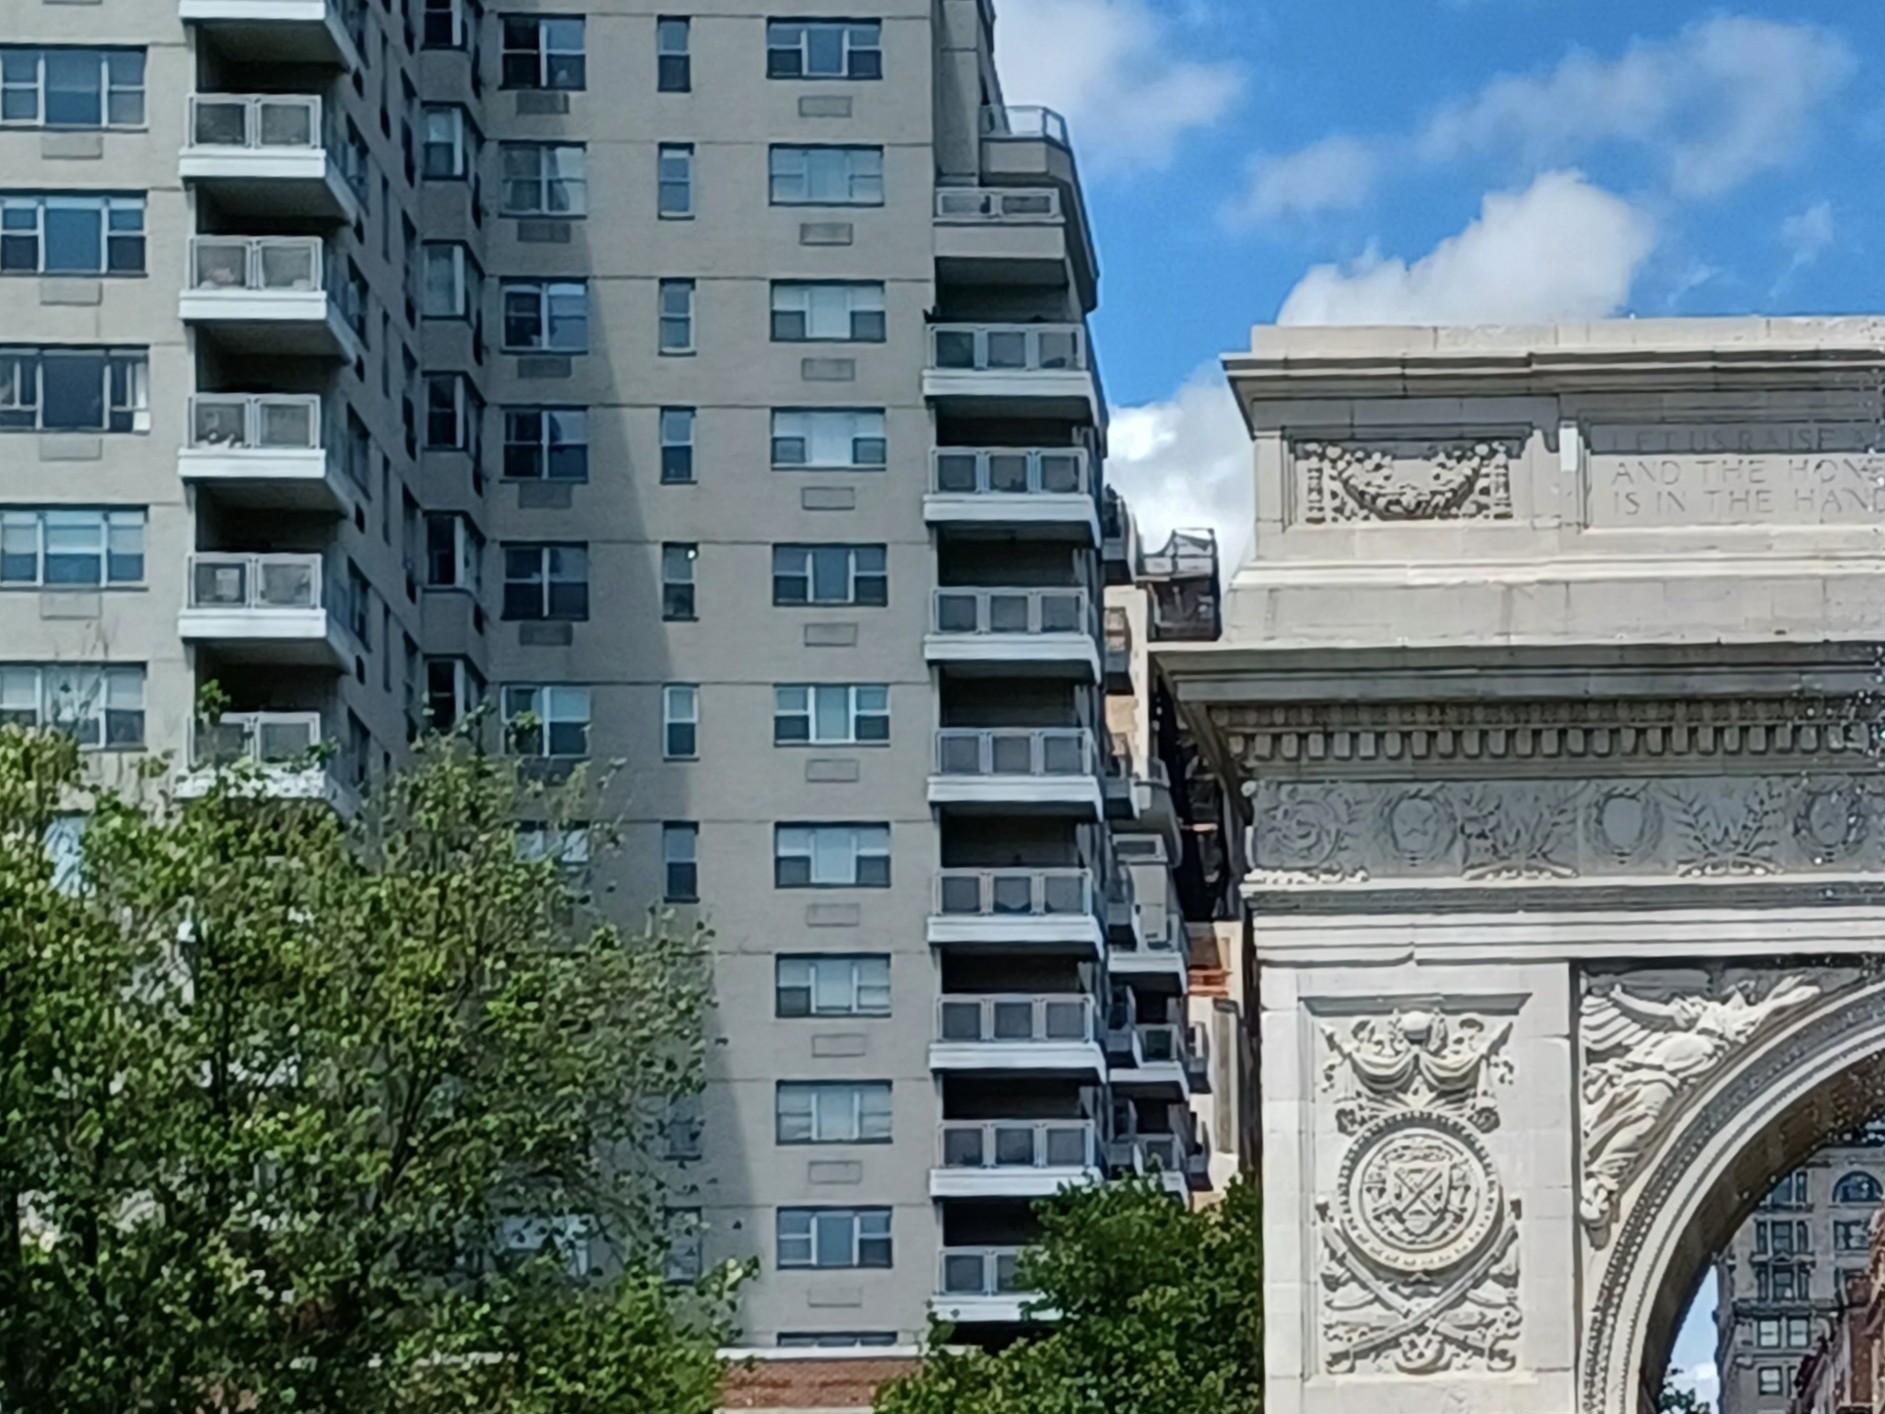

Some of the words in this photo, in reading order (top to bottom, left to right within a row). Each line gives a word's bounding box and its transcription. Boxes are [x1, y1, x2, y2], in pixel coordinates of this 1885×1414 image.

[1688, 427, 1725, 449] US
[1736, 427, 1835, 449] RAISE
[1611, 460, 1682, 485] AND
[1695, 459, 1767, 484] THE
[1613, 490, 1641, 516] IS
[1655, 490, 1687, 513] IN
[1703, 489, 1774, 514] THE
